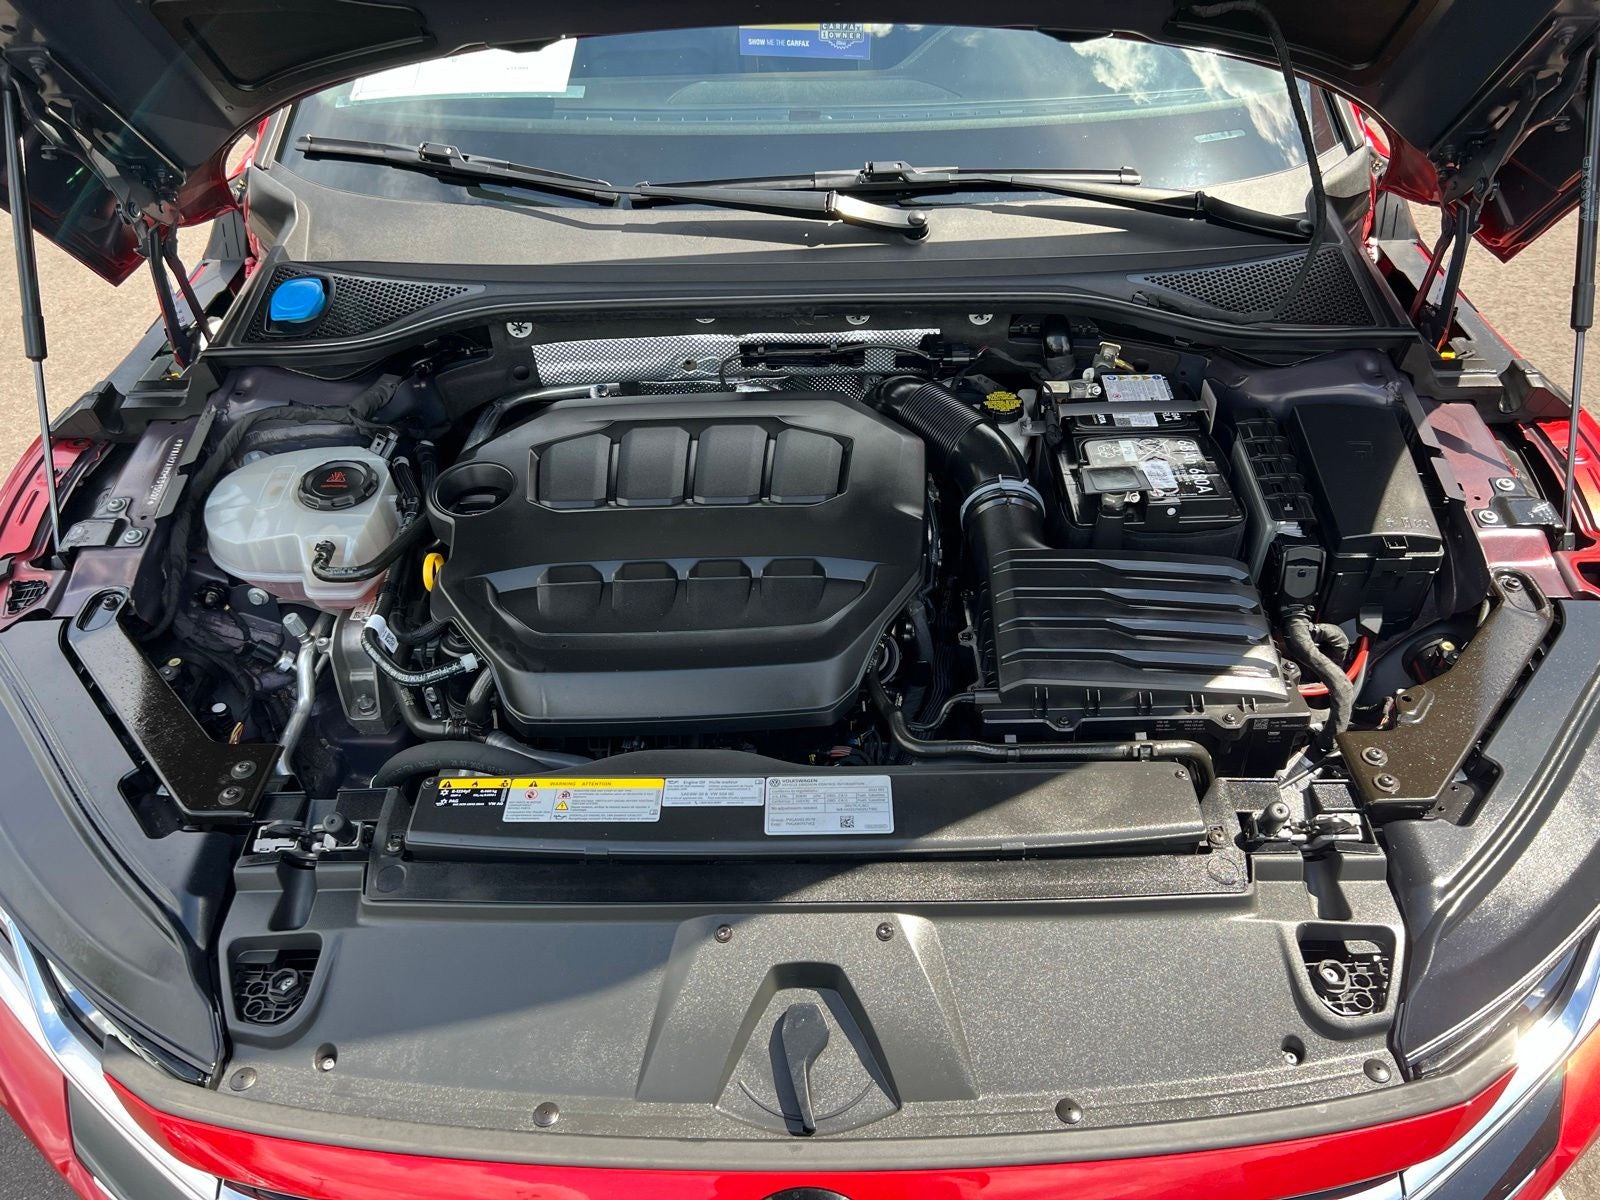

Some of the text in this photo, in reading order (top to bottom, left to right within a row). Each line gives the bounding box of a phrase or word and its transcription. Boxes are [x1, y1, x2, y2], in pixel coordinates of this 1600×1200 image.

[822, 23, 862, 31] CARFAX
[775, 39, 786, 47] THE
[786, 39, 810, 47] CARFAX
[1188, 468, 1214, 494] 680A
